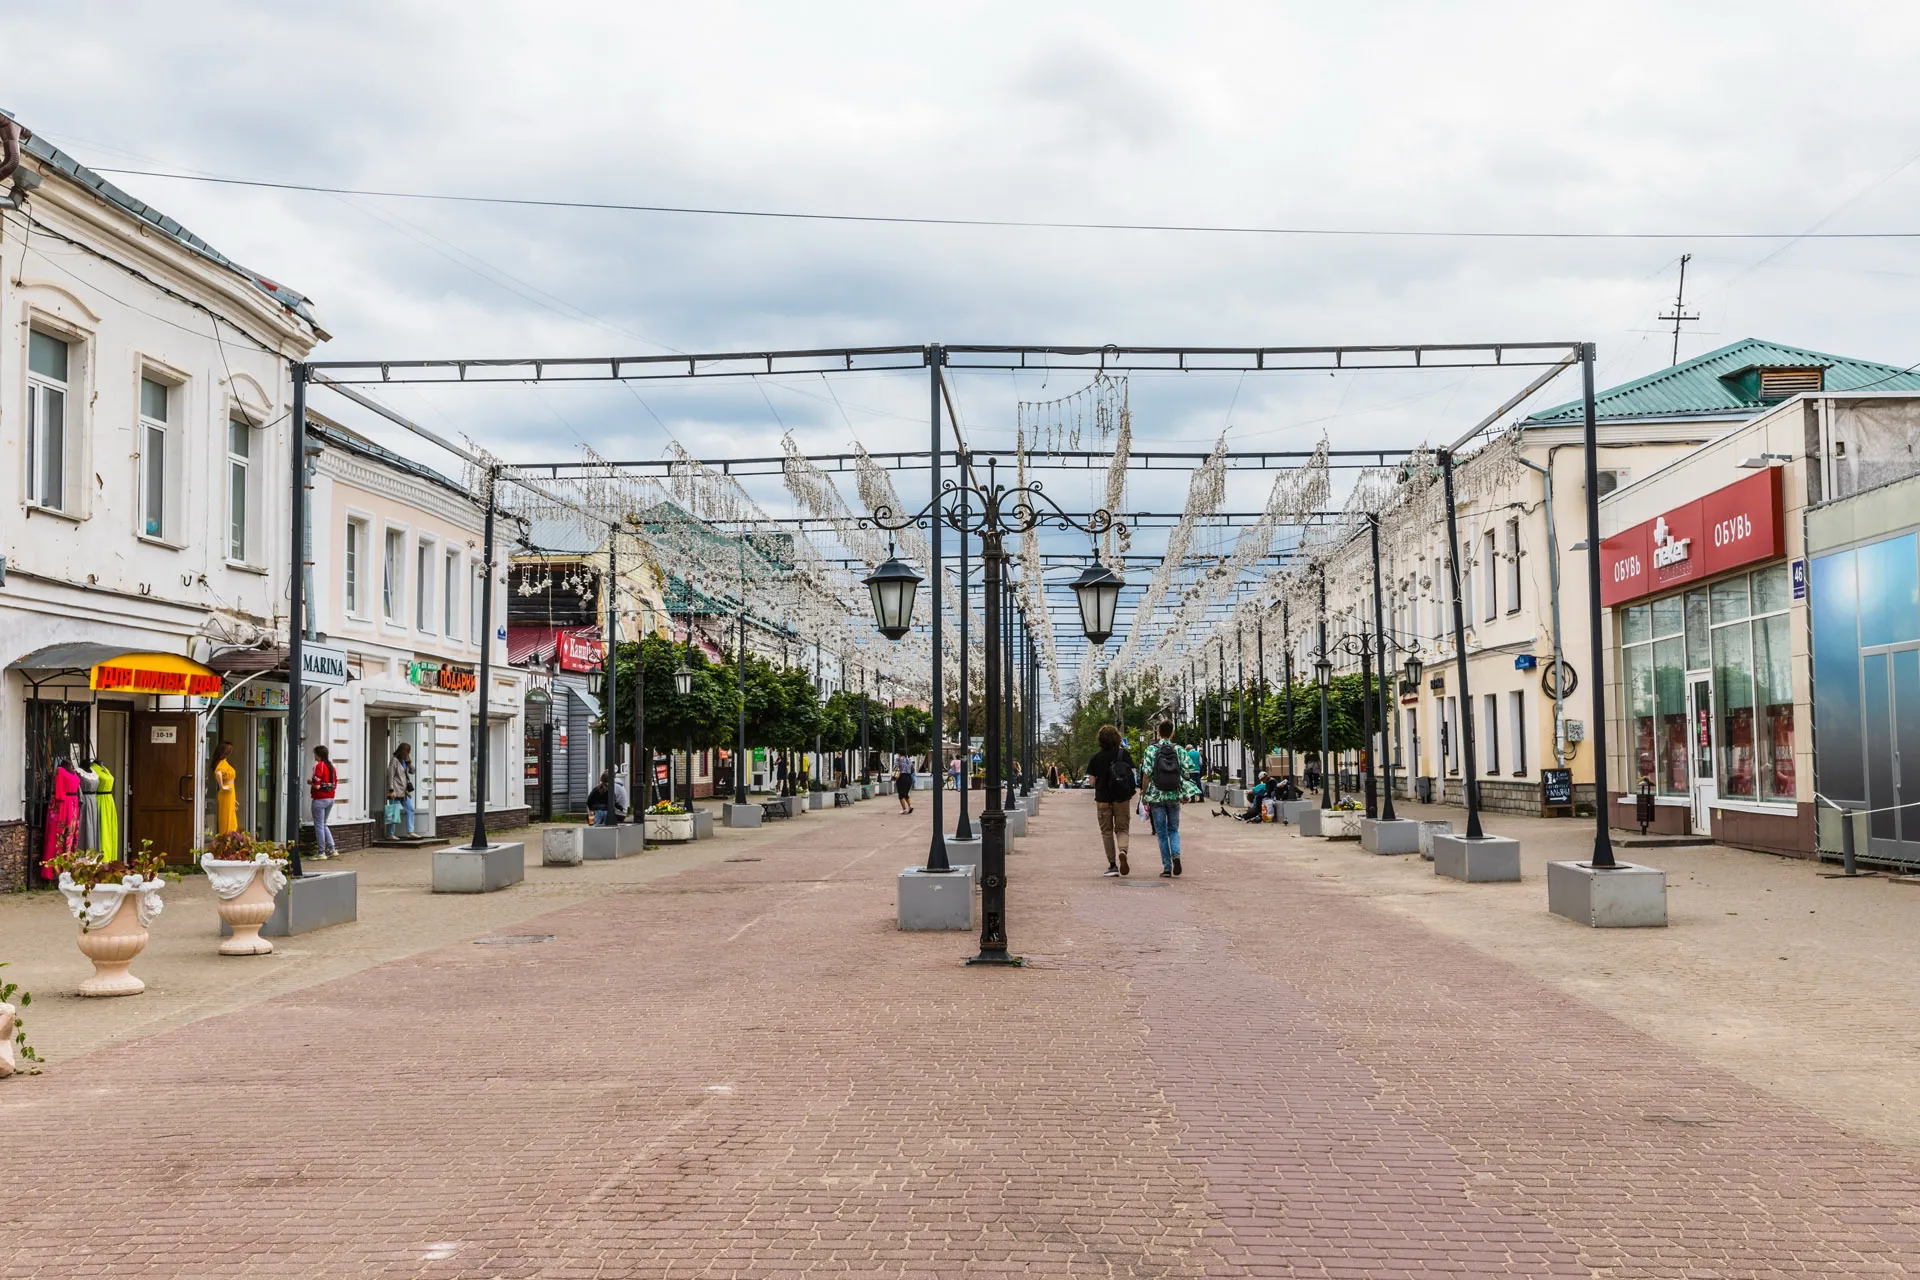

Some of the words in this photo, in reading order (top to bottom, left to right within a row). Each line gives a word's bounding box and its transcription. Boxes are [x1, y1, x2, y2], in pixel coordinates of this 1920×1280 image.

[1714, 513, 1752, 547] ОБУВЬ
[1614, 555, 1641, 582] ОБУВЬ
[1794, 566, 1803, 582] 46
[303, 653, 344, 677] MARINA
[97, 666, 133, 688] ДЛЯ
[134, 669, 187, 691] МИЛЫХ
[187, 674, 222, 694] ДАМ
[440, 669, 476, 692] ПОДАРКИ
